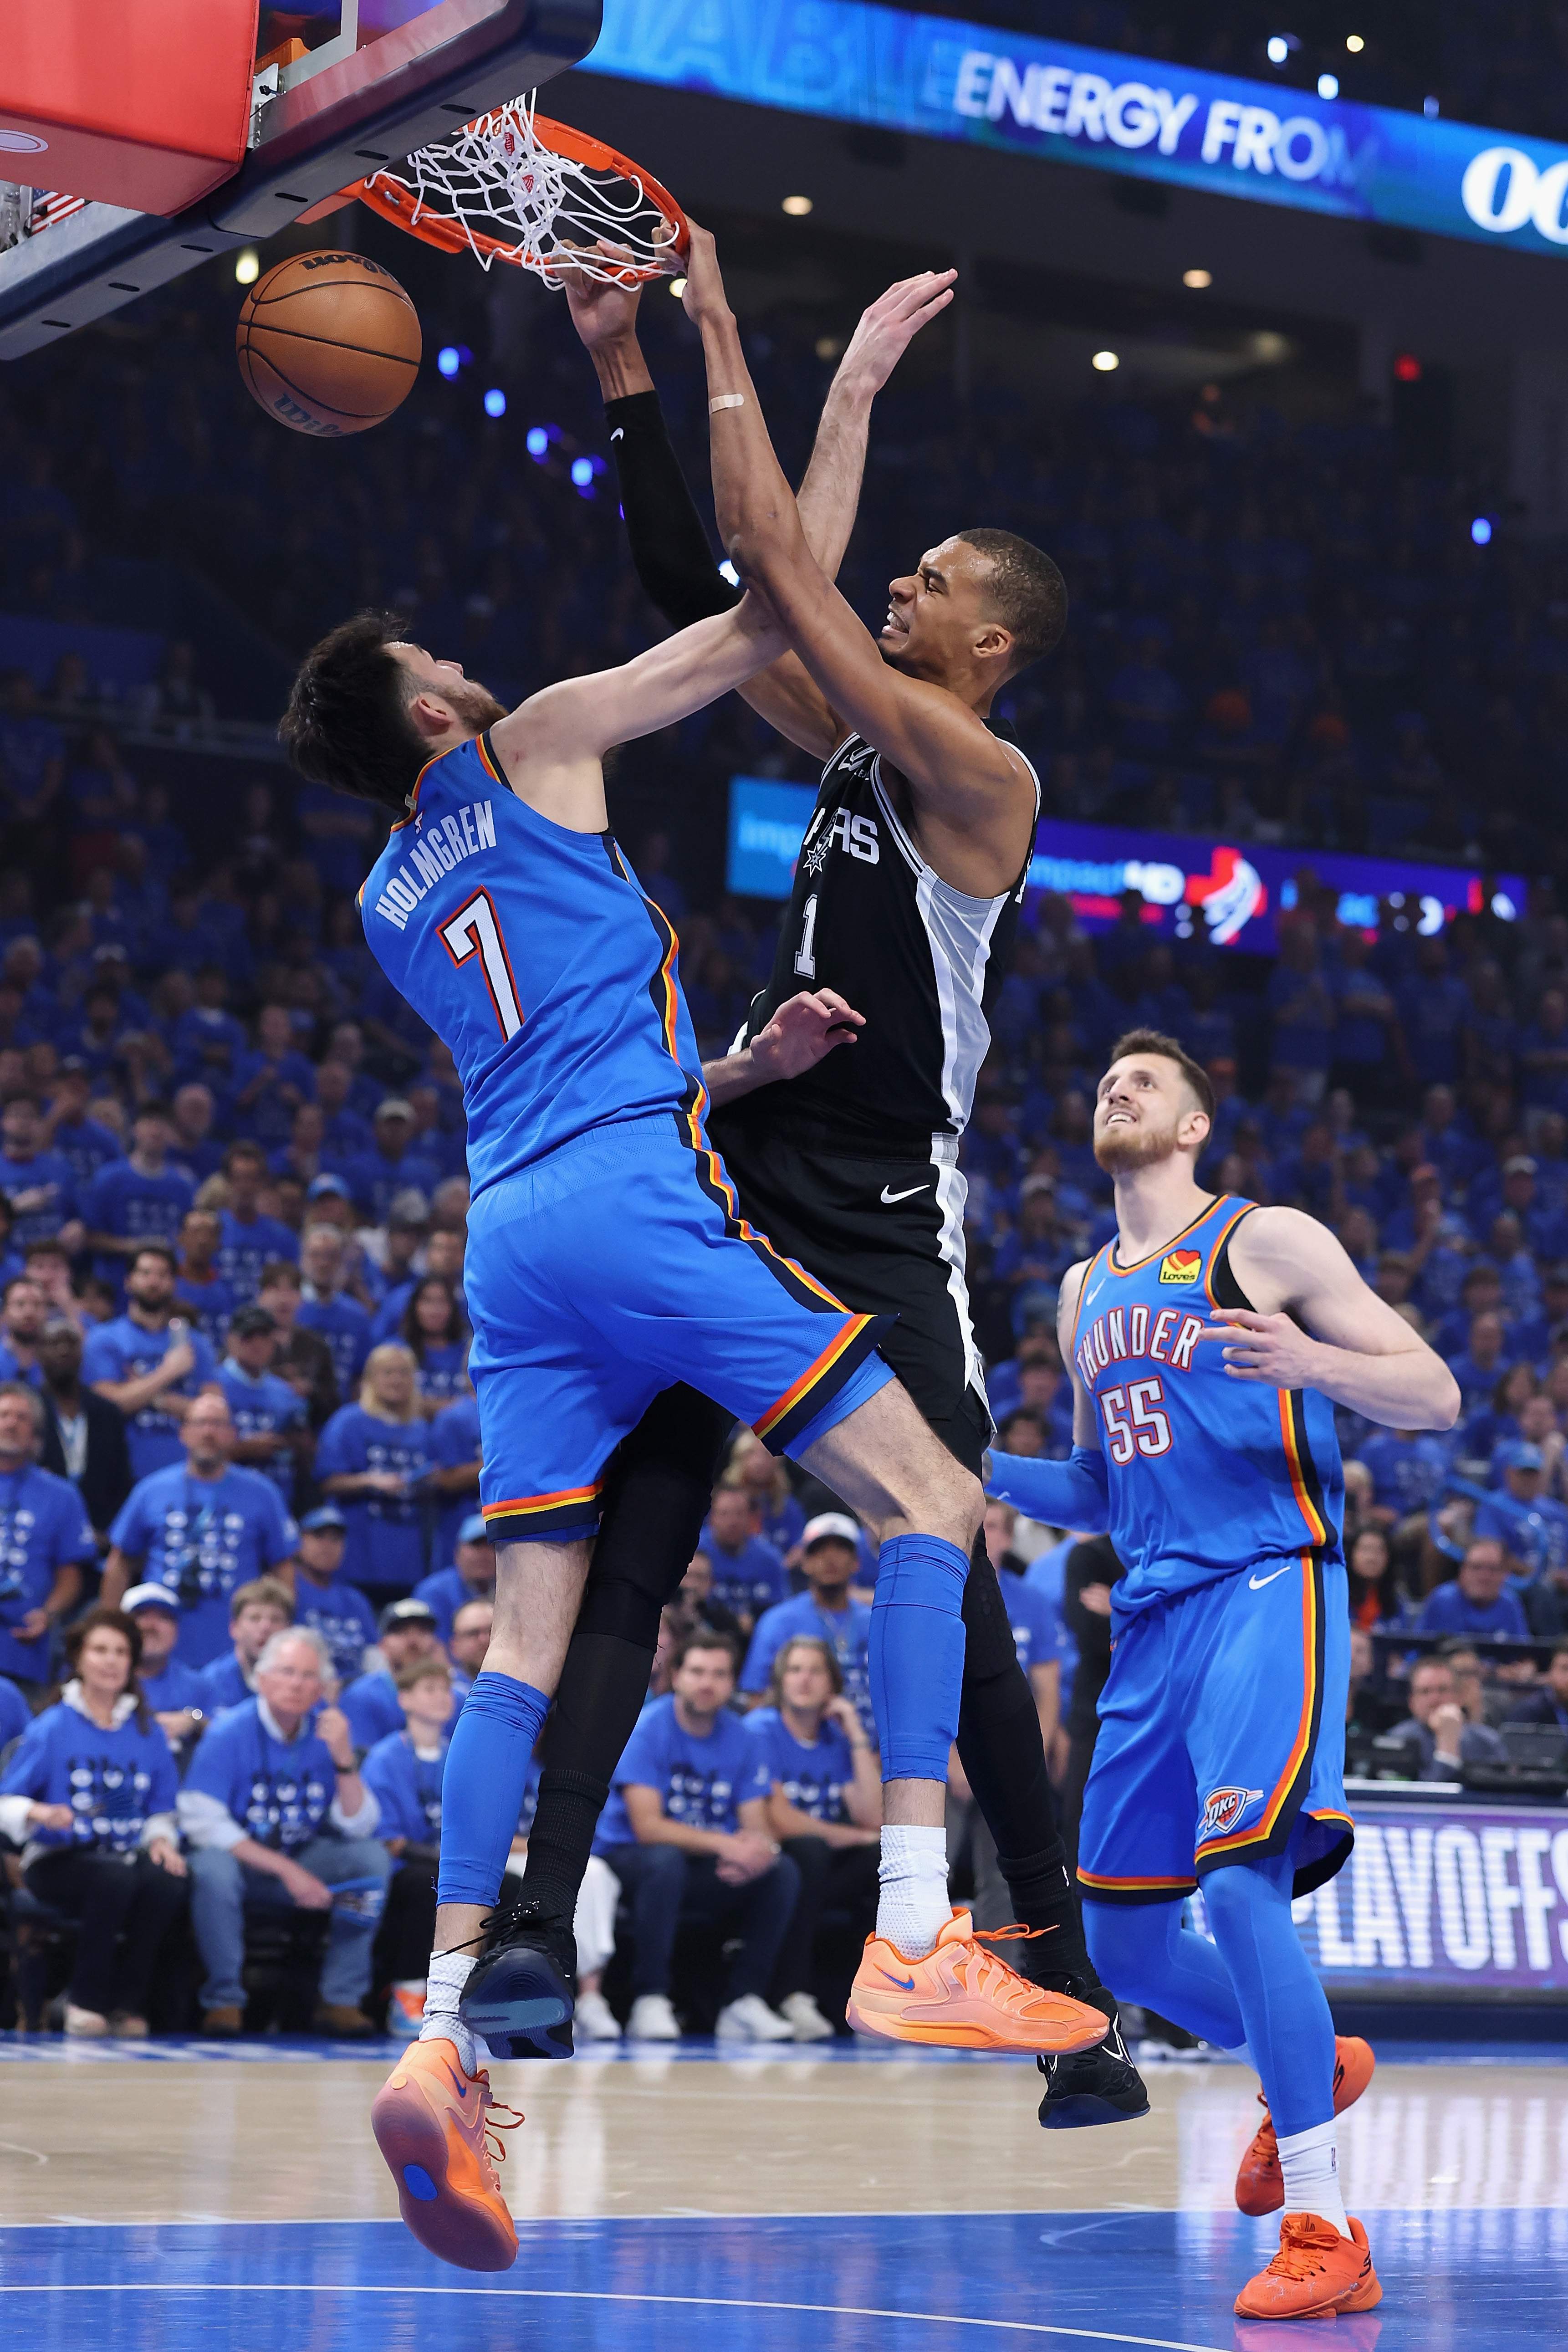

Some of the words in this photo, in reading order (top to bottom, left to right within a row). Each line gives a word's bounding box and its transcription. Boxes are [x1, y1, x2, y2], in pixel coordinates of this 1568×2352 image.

[953, 50, 1199, 156] ENERGY
[375, 800, 497, 931] HOLMGREN
[435, 884, 525, 1043] 7
[793, 893, 817, 980] 1
[1077, 1305, 1205, 1391] THUNDER
[1098, 1375, 1173, 1466] 55
[1207, 1794, 1236, 1830] OKC
